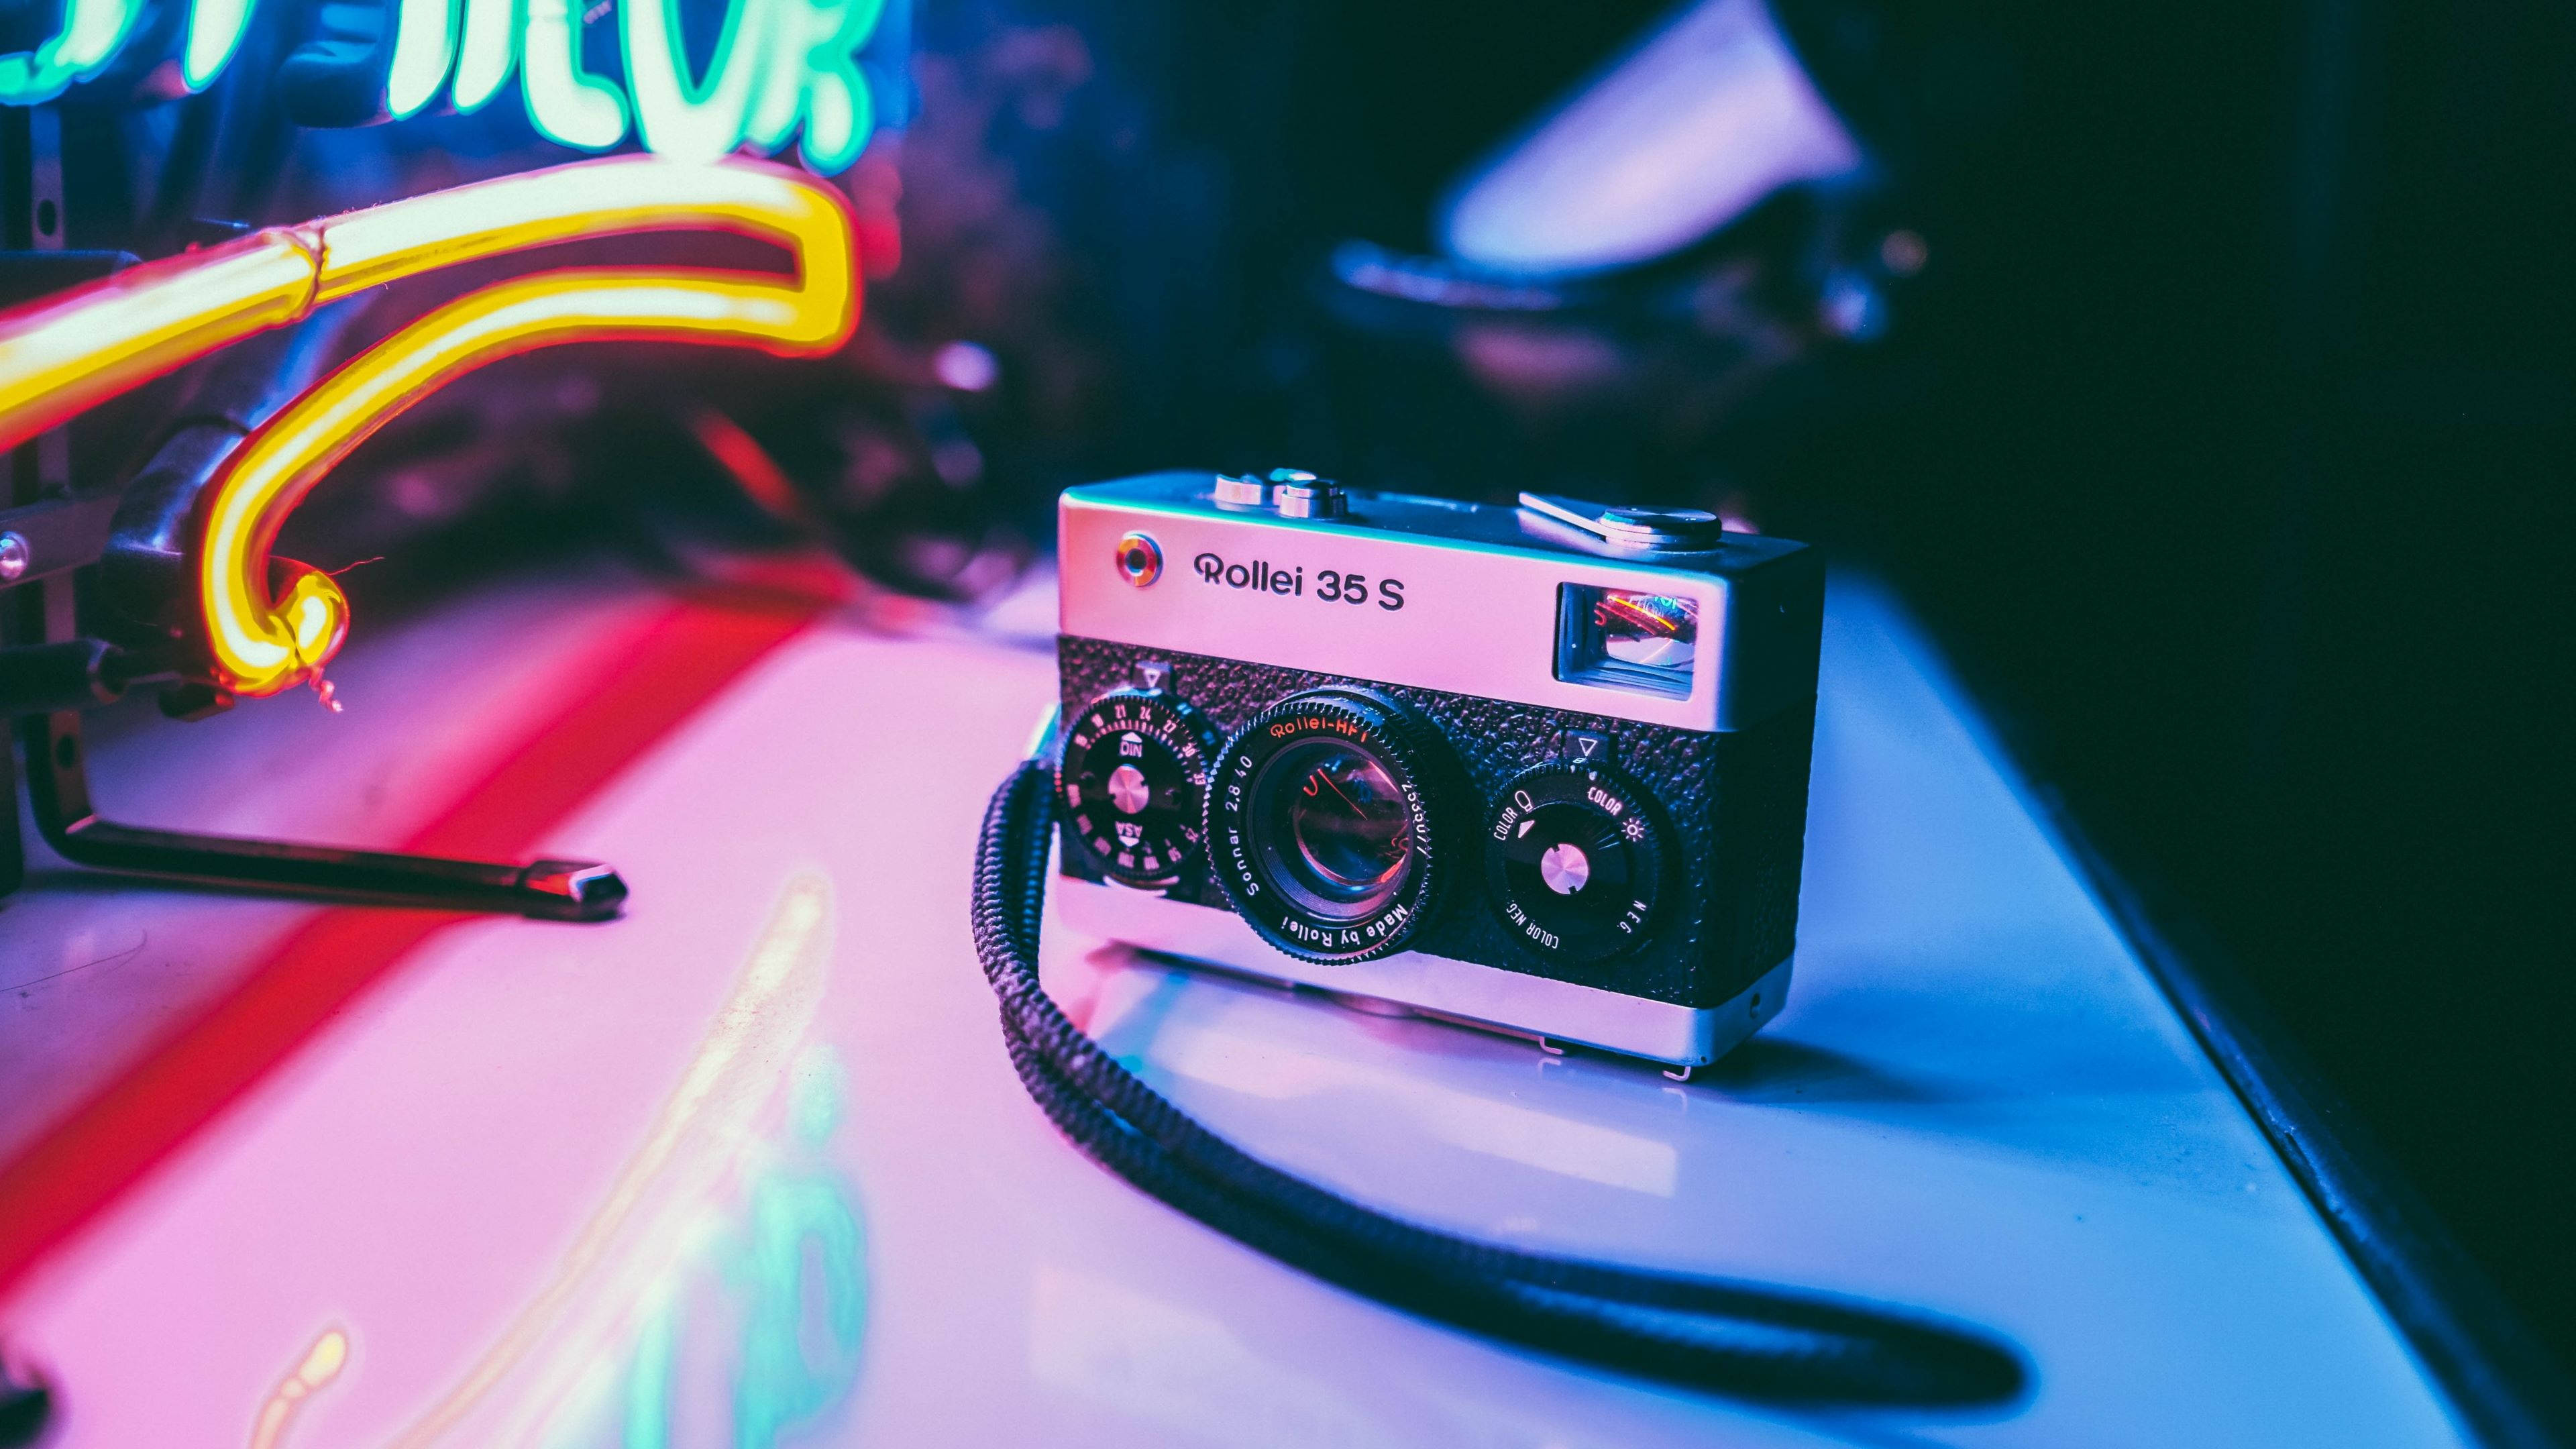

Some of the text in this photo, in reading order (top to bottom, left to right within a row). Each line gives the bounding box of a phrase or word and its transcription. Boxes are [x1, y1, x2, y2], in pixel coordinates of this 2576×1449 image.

[1193, 553, 1405, 611] Rollei 35 S
[1114, 704, 1128, 720] 21
[1139, 706, 1152, 721] 24
[1163, 719, 1177, 733] 27
[1120, 741, 1143, 758] DIN
[1182, 742, 1195, 757] 30
[1193, 772, 1206, 786] 33
[1587, 786, 1623, 816] COLOR
[1115, 821, 1142, 838] ASA
[1493, 806, 1517, 841] COLOR
[1185, 827, 1199, 844] 25
[1228, 826, 1260, 896] Sonnar
[1281, 904, 1409, 947] Made by Rollei
[1506, 902, 1559, 949] COLOR NEG
